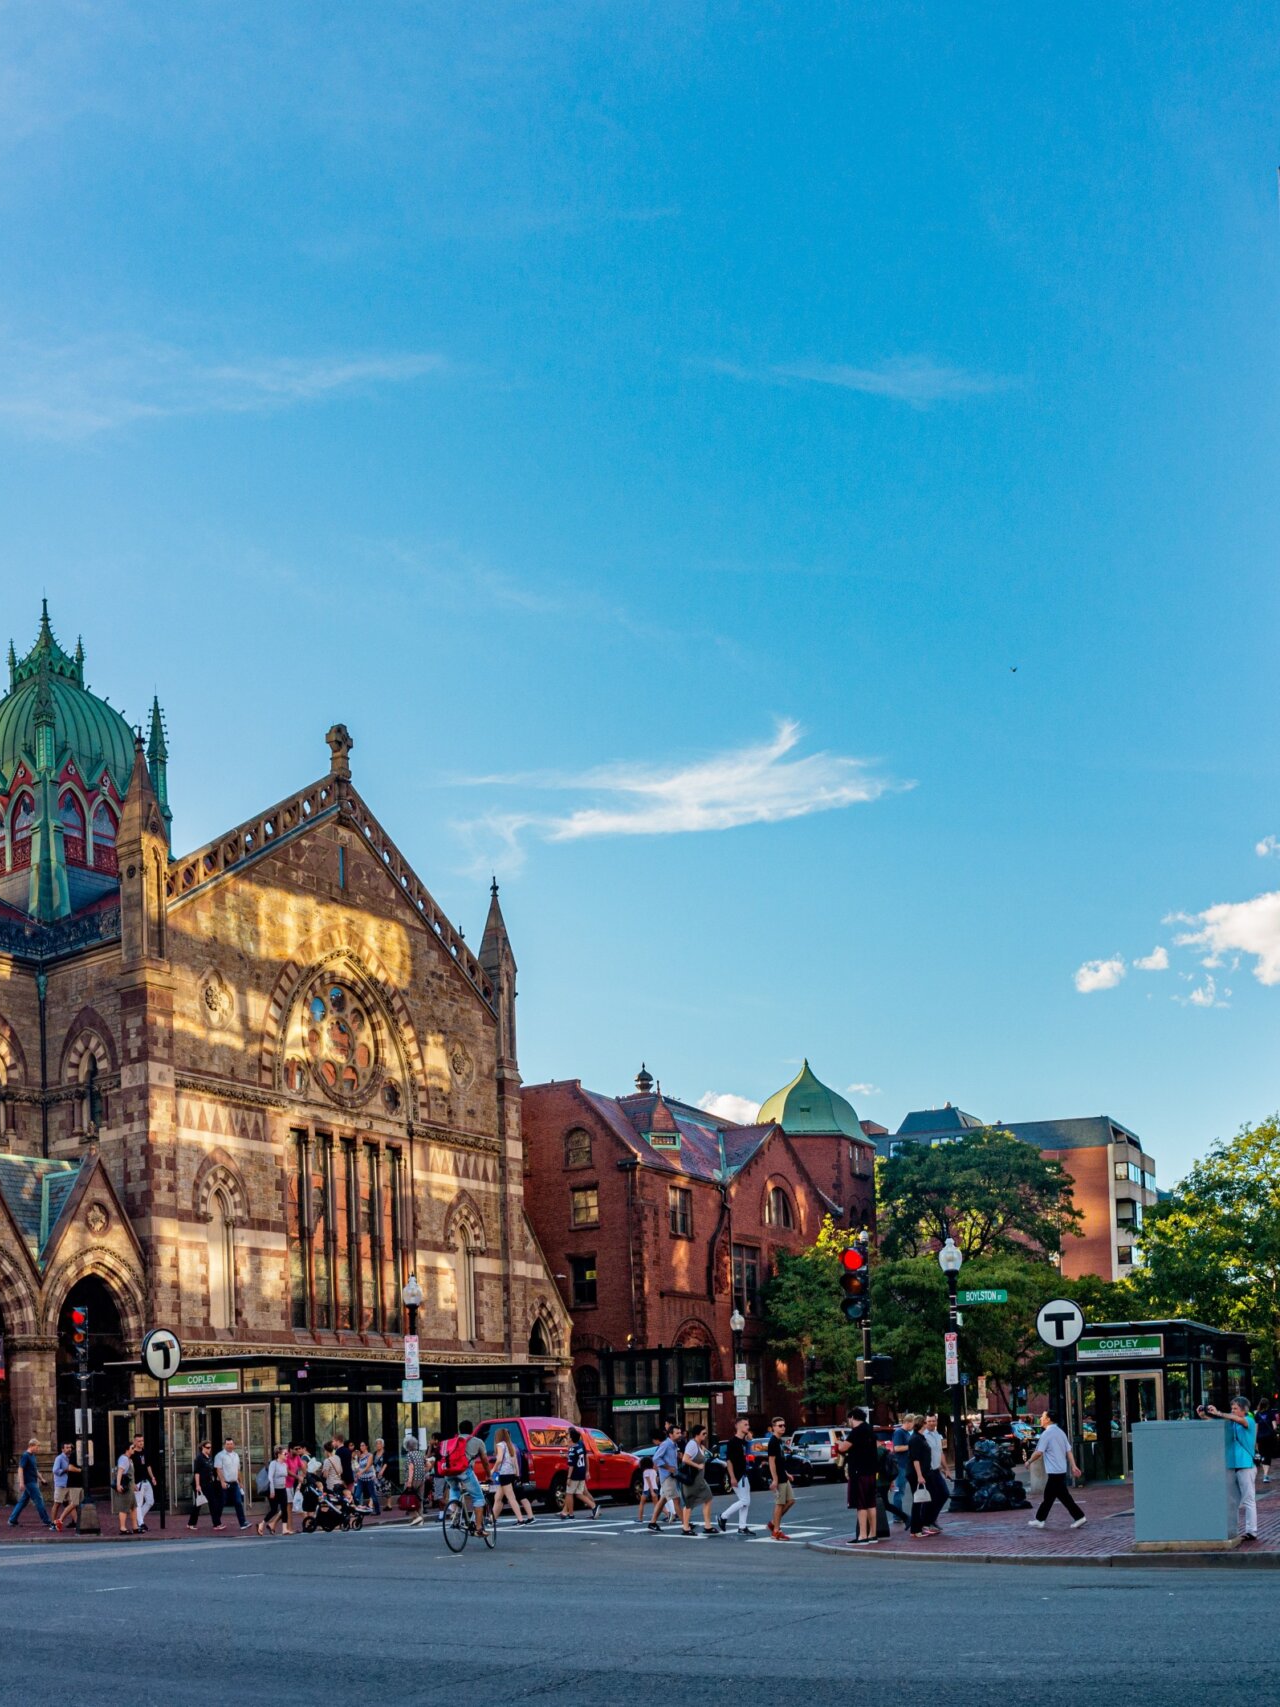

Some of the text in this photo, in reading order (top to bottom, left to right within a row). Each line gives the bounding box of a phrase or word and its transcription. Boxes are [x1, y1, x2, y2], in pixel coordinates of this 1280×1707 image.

[966, 1291, 997, 1301] BOYLSTON
[1044, 1312, 1075, 1340] T
[1099, 1339, 1139, 1349] COPLEY
[152, 1340, 175, 1370] T
[187, 1375, 217, 1384] COPLEY
